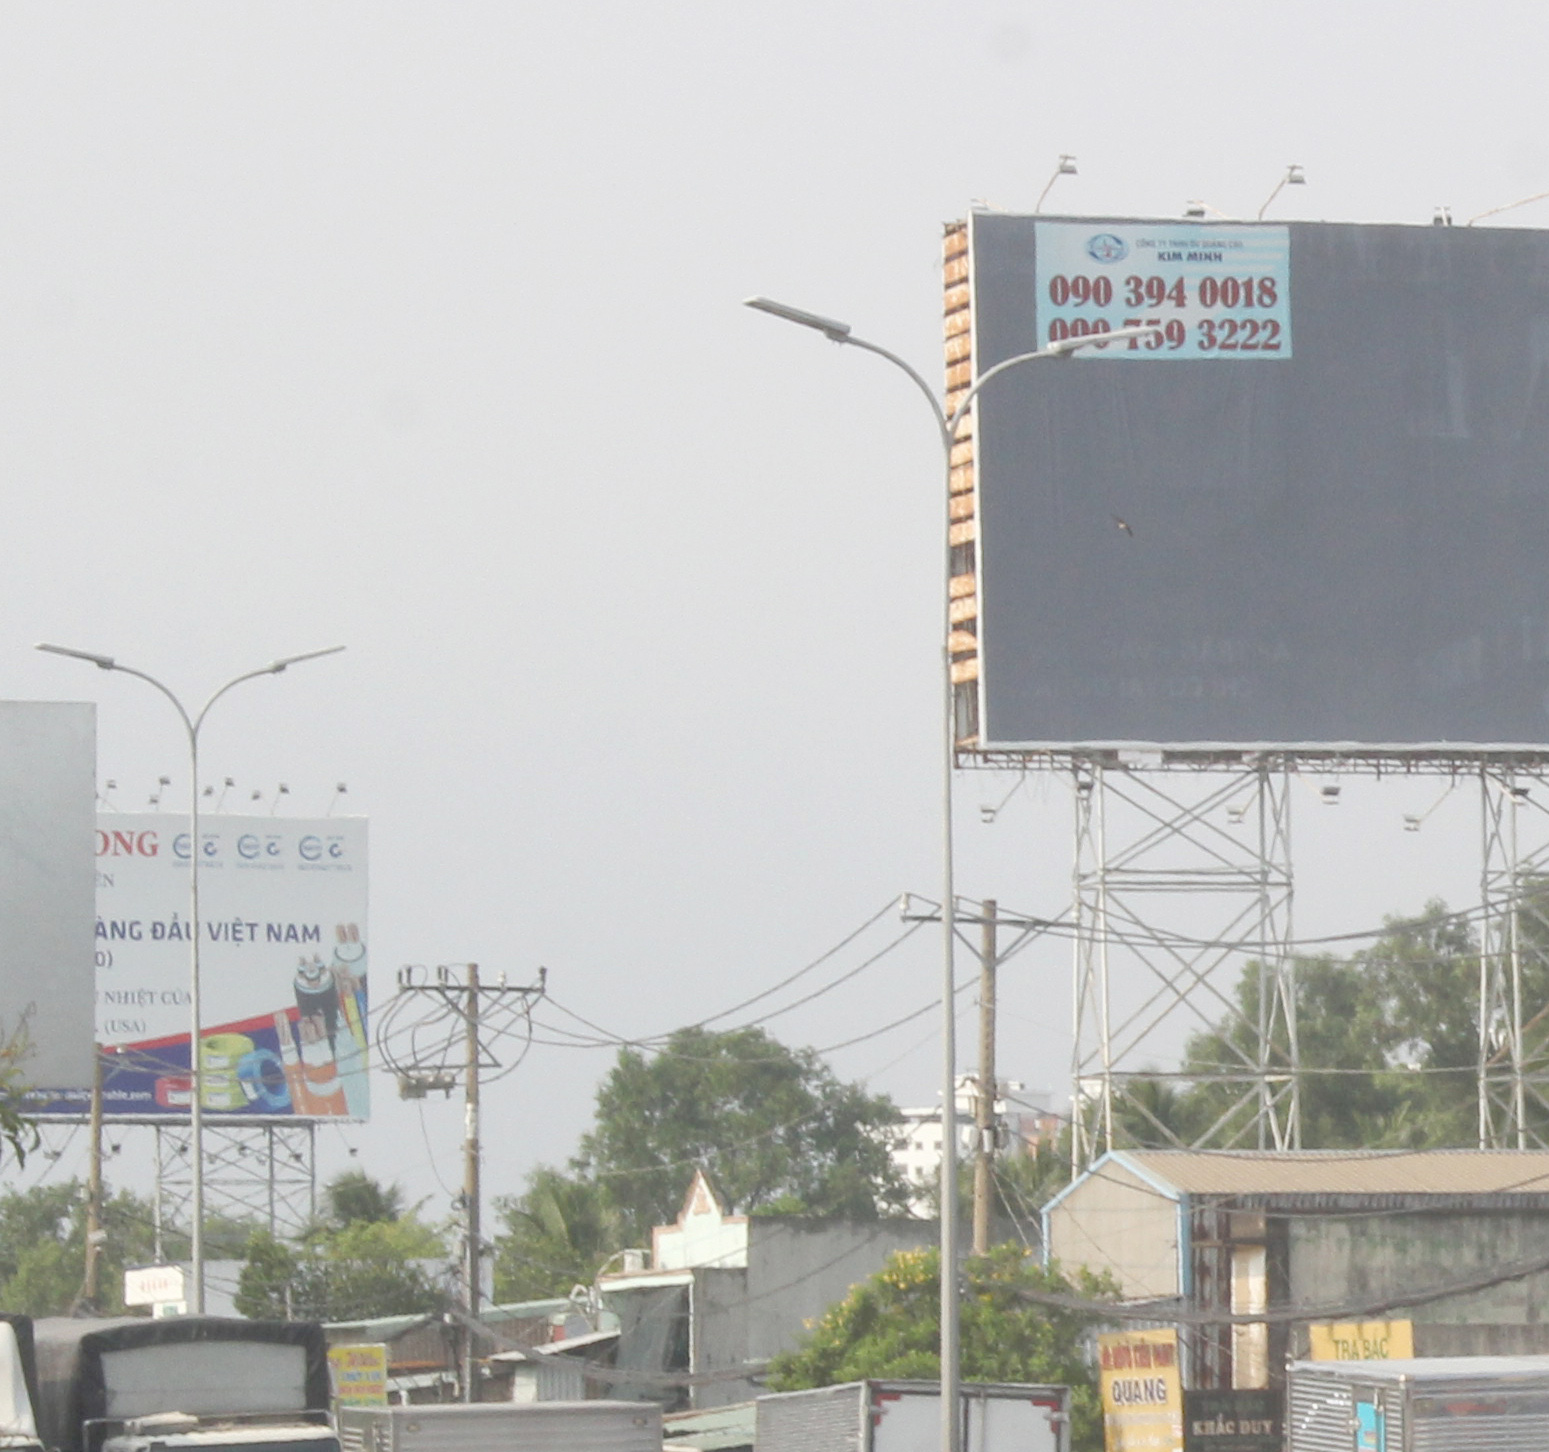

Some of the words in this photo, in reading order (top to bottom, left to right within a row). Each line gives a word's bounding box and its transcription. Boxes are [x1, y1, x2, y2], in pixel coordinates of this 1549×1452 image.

[1157, 251, 1183, 262] KIM
[1186, 251, 1223, 262] MINH
[1048, 274, 1113, 308] 090
[1124, 275, 1187, 309] 394
[1198, 275, 1278, 309] 0018
[1197, 318, 1282, 352] 3222
[207, 916, 259, 947] VIỆT
[266, 922, 321, 944] NAM
